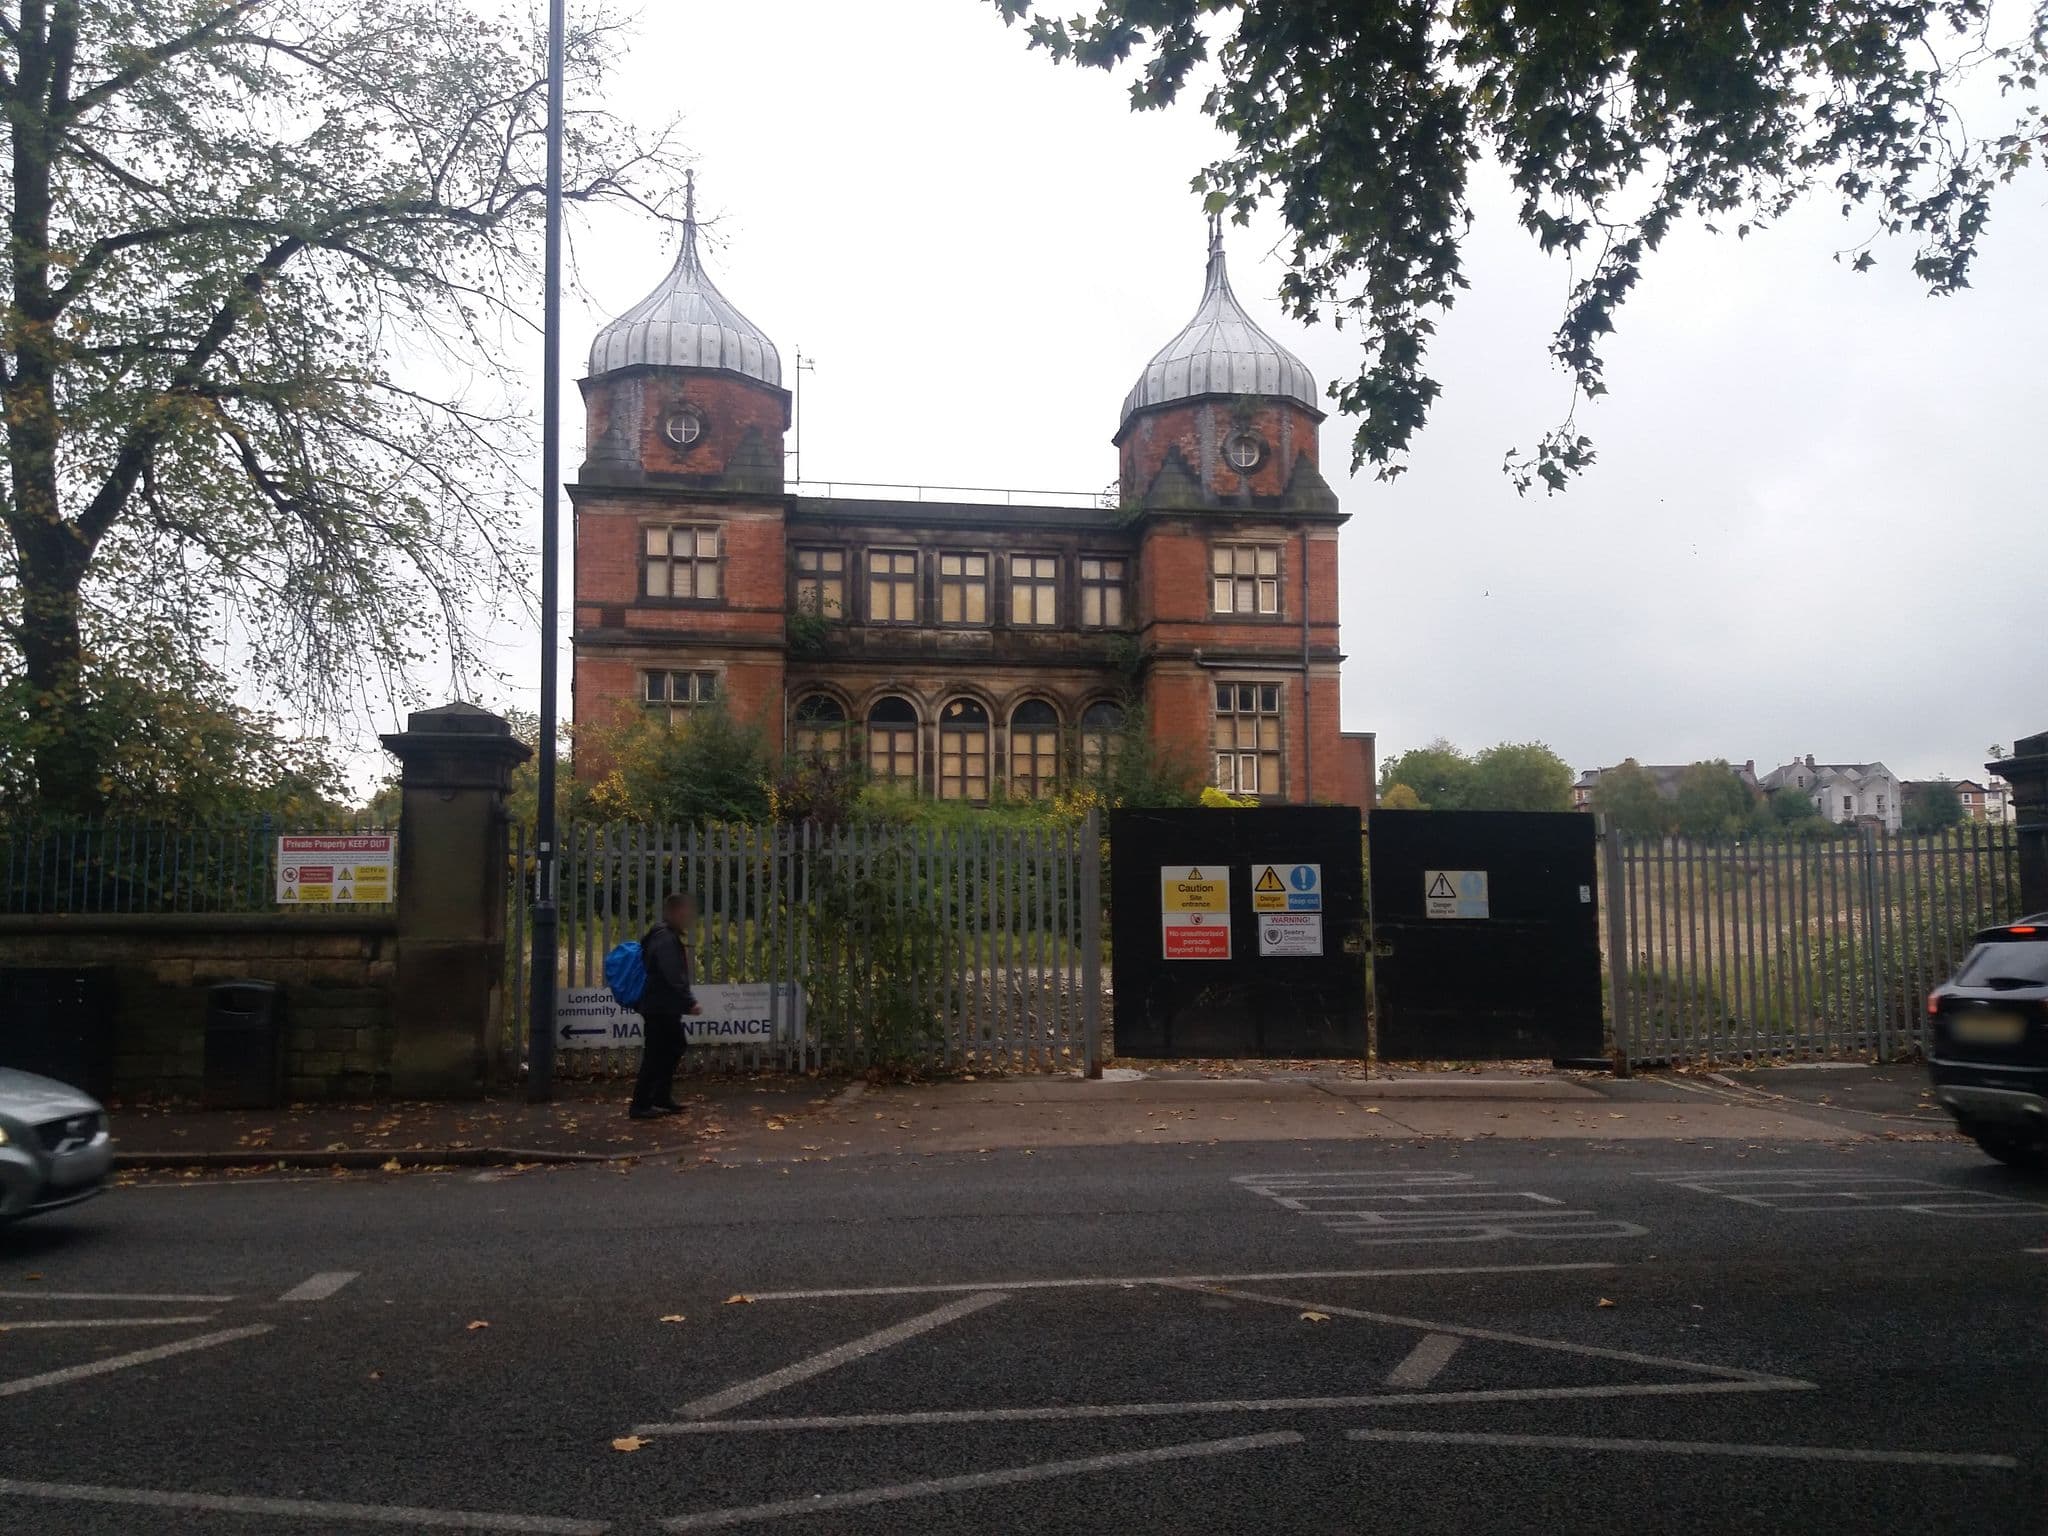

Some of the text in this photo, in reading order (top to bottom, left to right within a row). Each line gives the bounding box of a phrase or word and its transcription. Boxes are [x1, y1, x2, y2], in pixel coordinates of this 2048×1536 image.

[286, 839, 386, 850] Private Property KEEP OUT
[1177, 884, 1214, 893] Caution
[1270, 916, 1311, 924] WARNING!
[1168, 947, 1194, 955] beyond
[1208, 946, 1226, 954] point
[567, 993, 613, 1004] London
[557, 1005, 616, 1018] ommunity
[680, 1019, 772, 1036] NTRANCE
